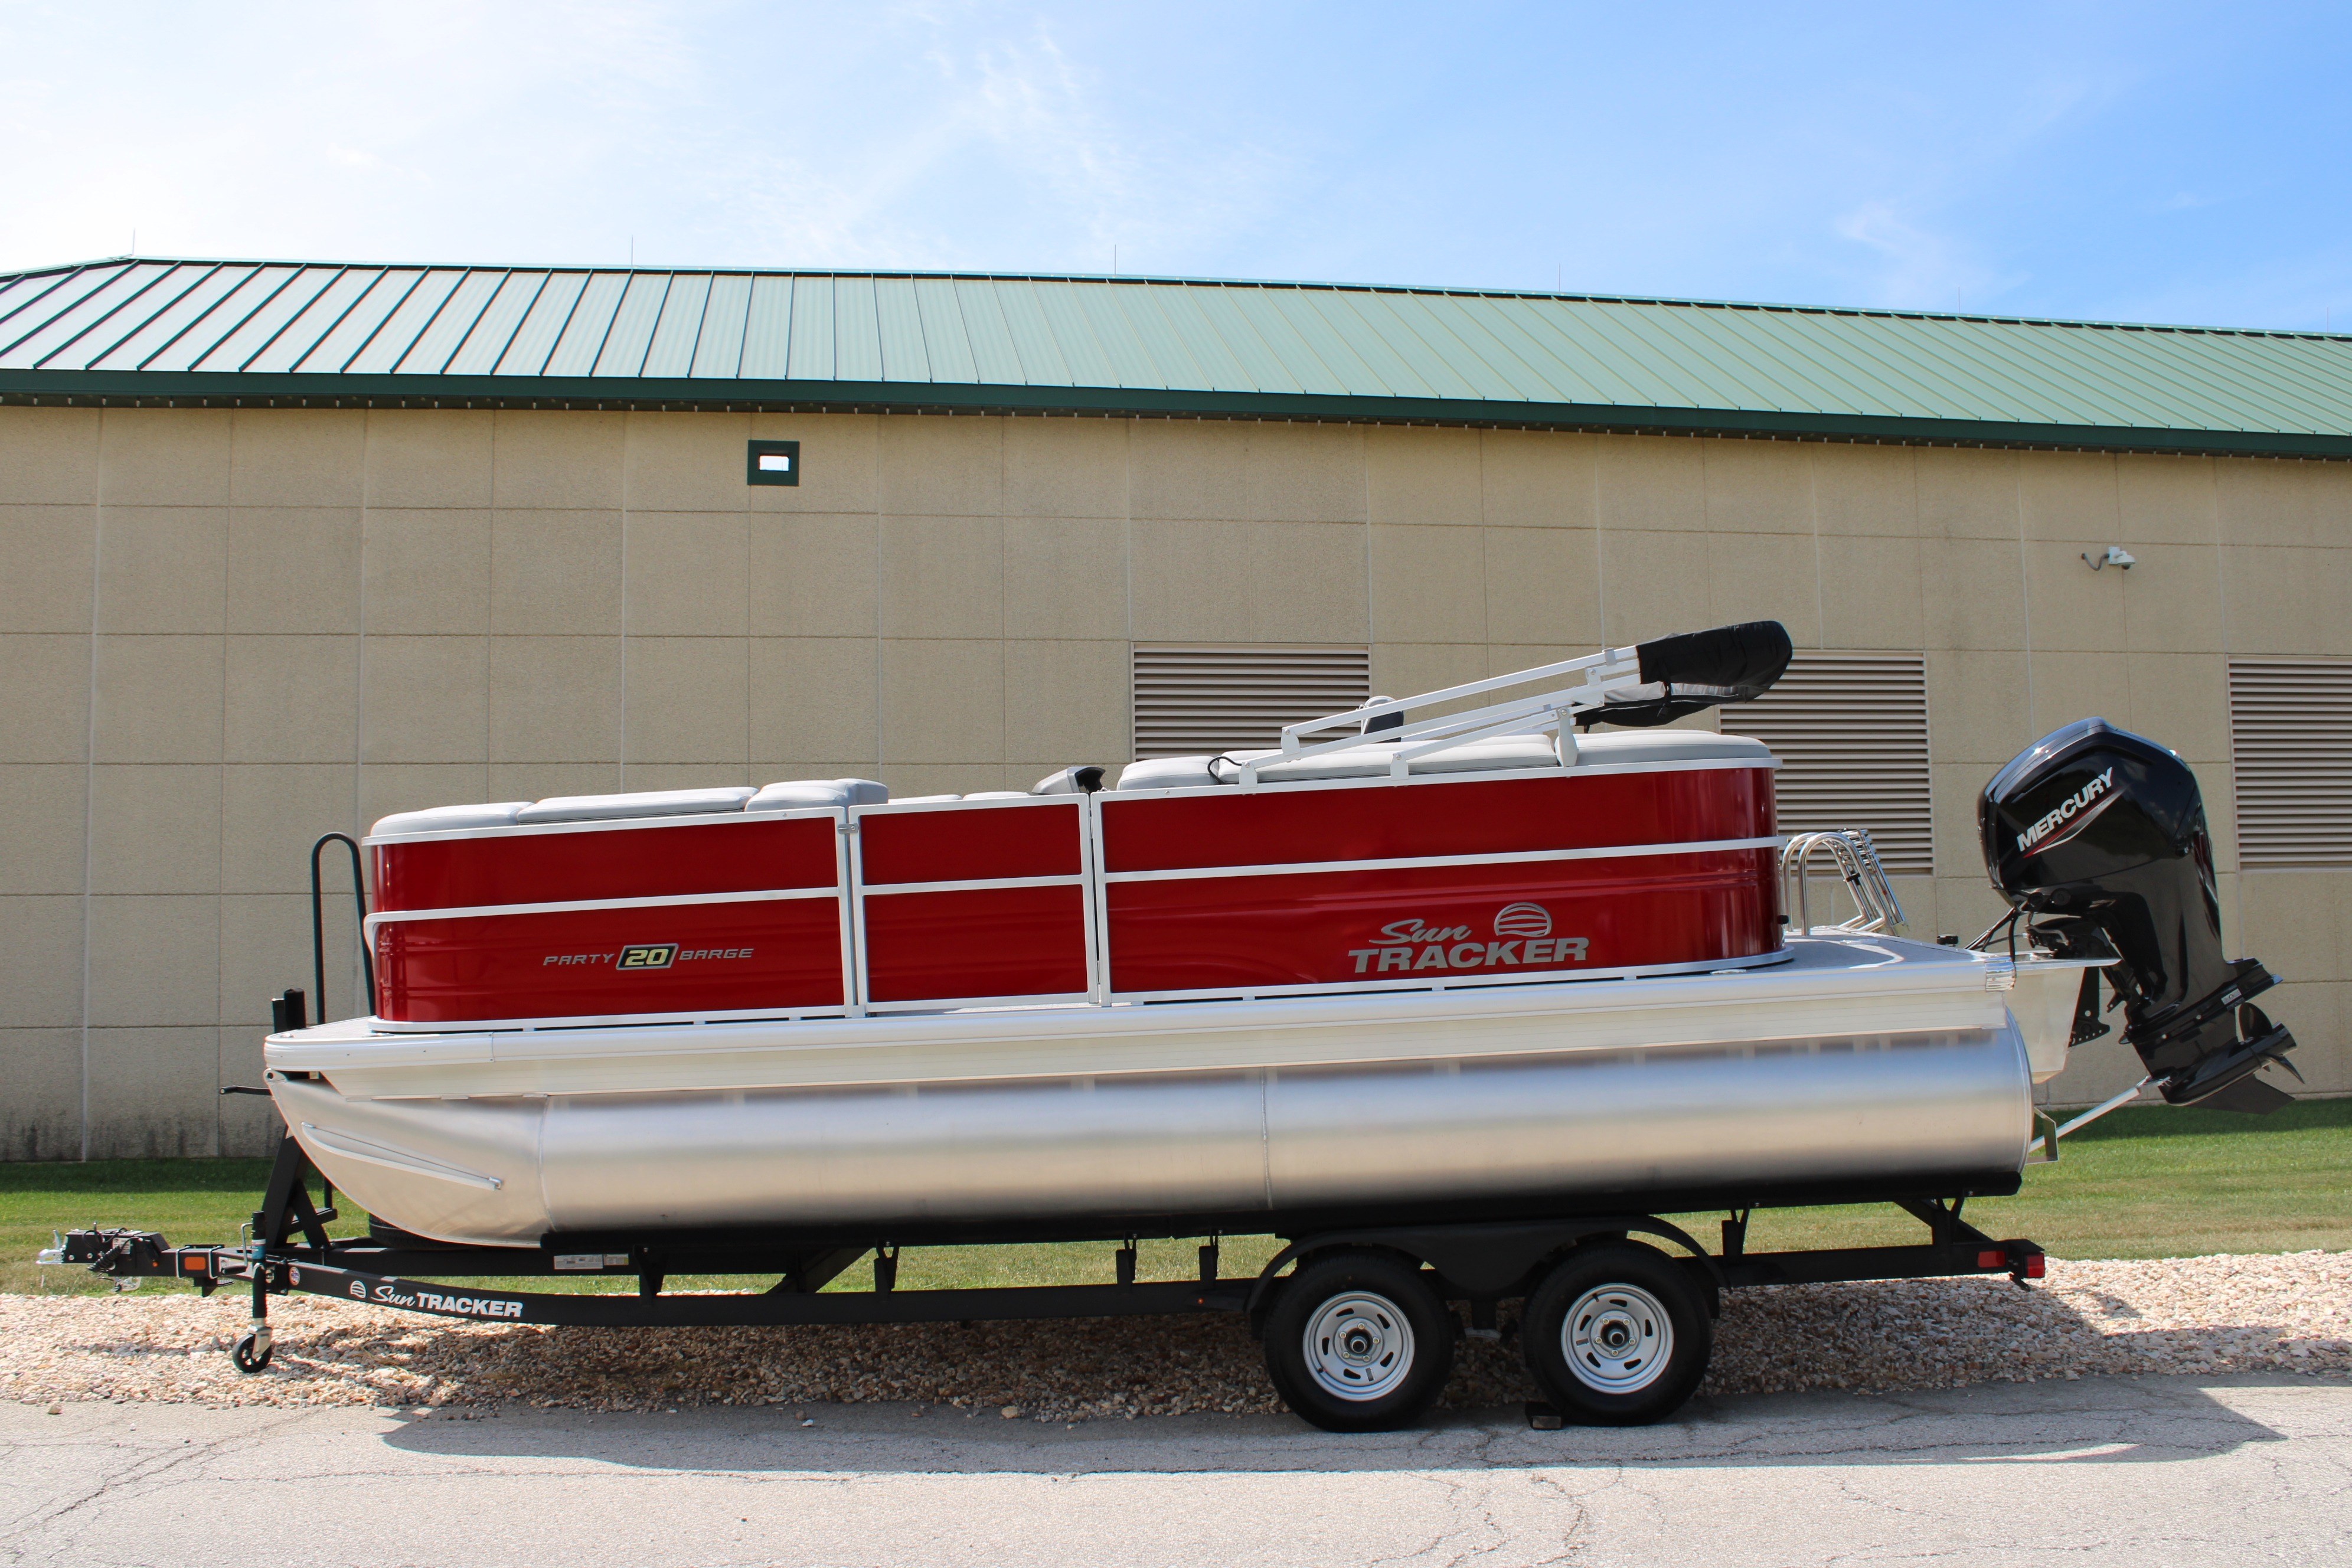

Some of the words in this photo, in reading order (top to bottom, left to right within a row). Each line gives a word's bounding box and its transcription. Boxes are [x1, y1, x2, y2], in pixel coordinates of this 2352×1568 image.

[2016, 766, 2113, 852] MERCURY
[1368, 919, 1472, 945] Sun
[543, 953, 615, 966] PARTY
[625, 948, 669, 966] 20
[679, 948, 754, 961] BARGE
[1348, 937, 1590, 974] TRACKER
[370, 1285, 416, 1307] Sun
[416, 1292, 524, 1318] TRACKER
